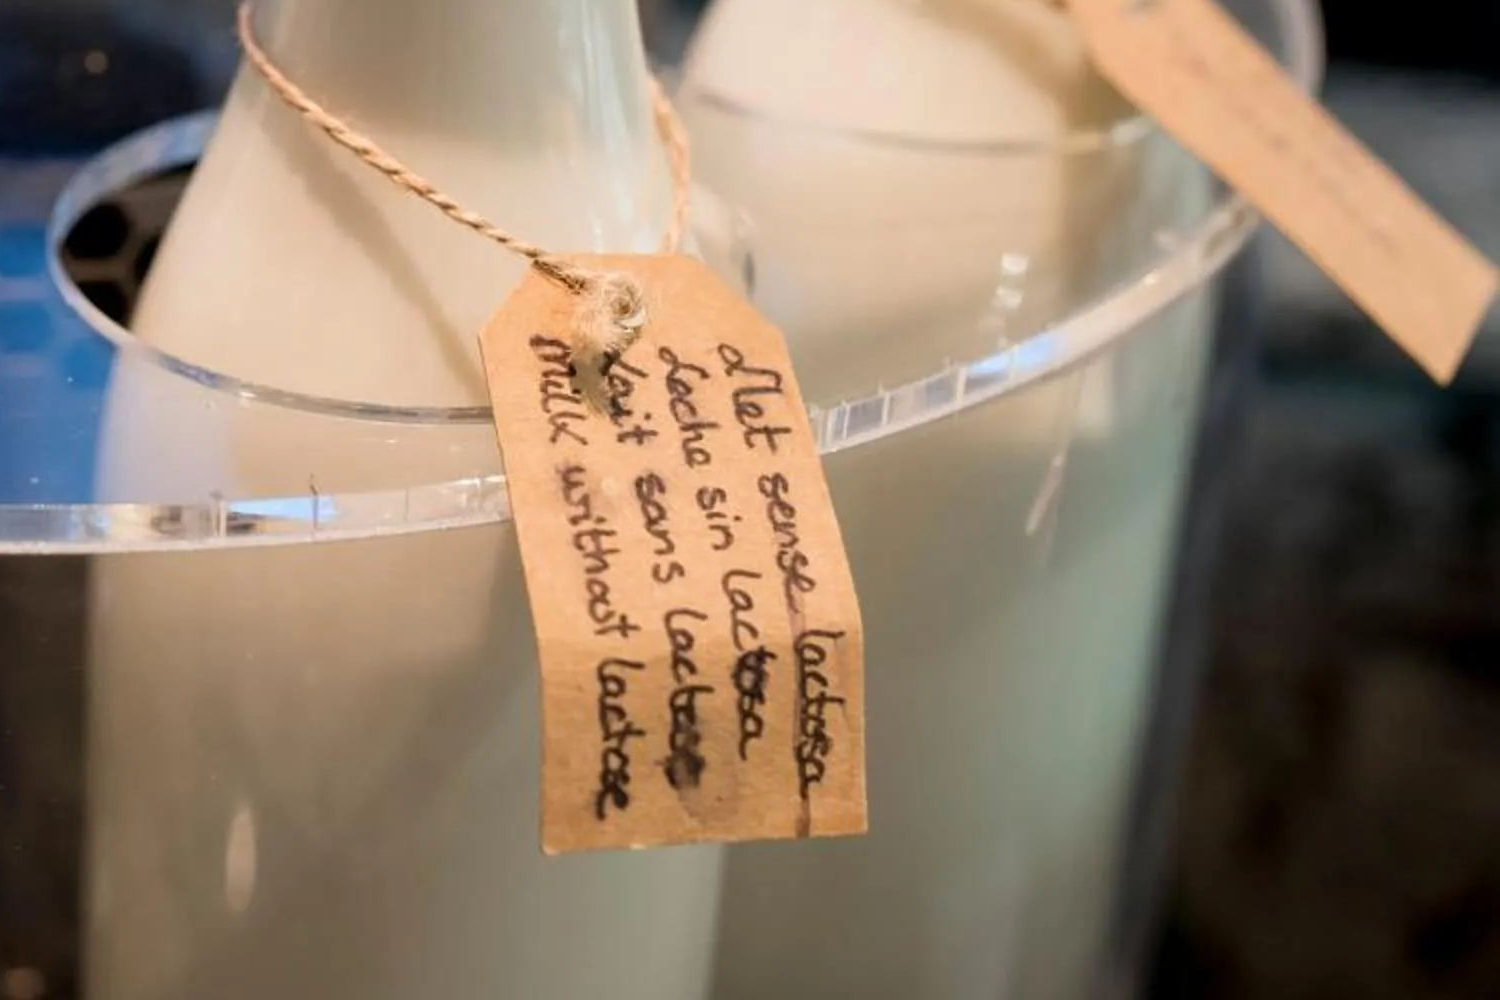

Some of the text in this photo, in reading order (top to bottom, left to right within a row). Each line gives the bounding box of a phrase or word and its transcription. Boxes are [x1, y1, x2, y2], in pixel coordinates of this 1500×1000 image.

[557, 465, 639, 639] without
[635, 472, 685, 585] sans
[659, 346, 778, 760] Leche sin lactosa
[758, 472, 816, 613] sense
[795, 629, 845, 800] lactosa
[594, 659, 645, 820] lactose
